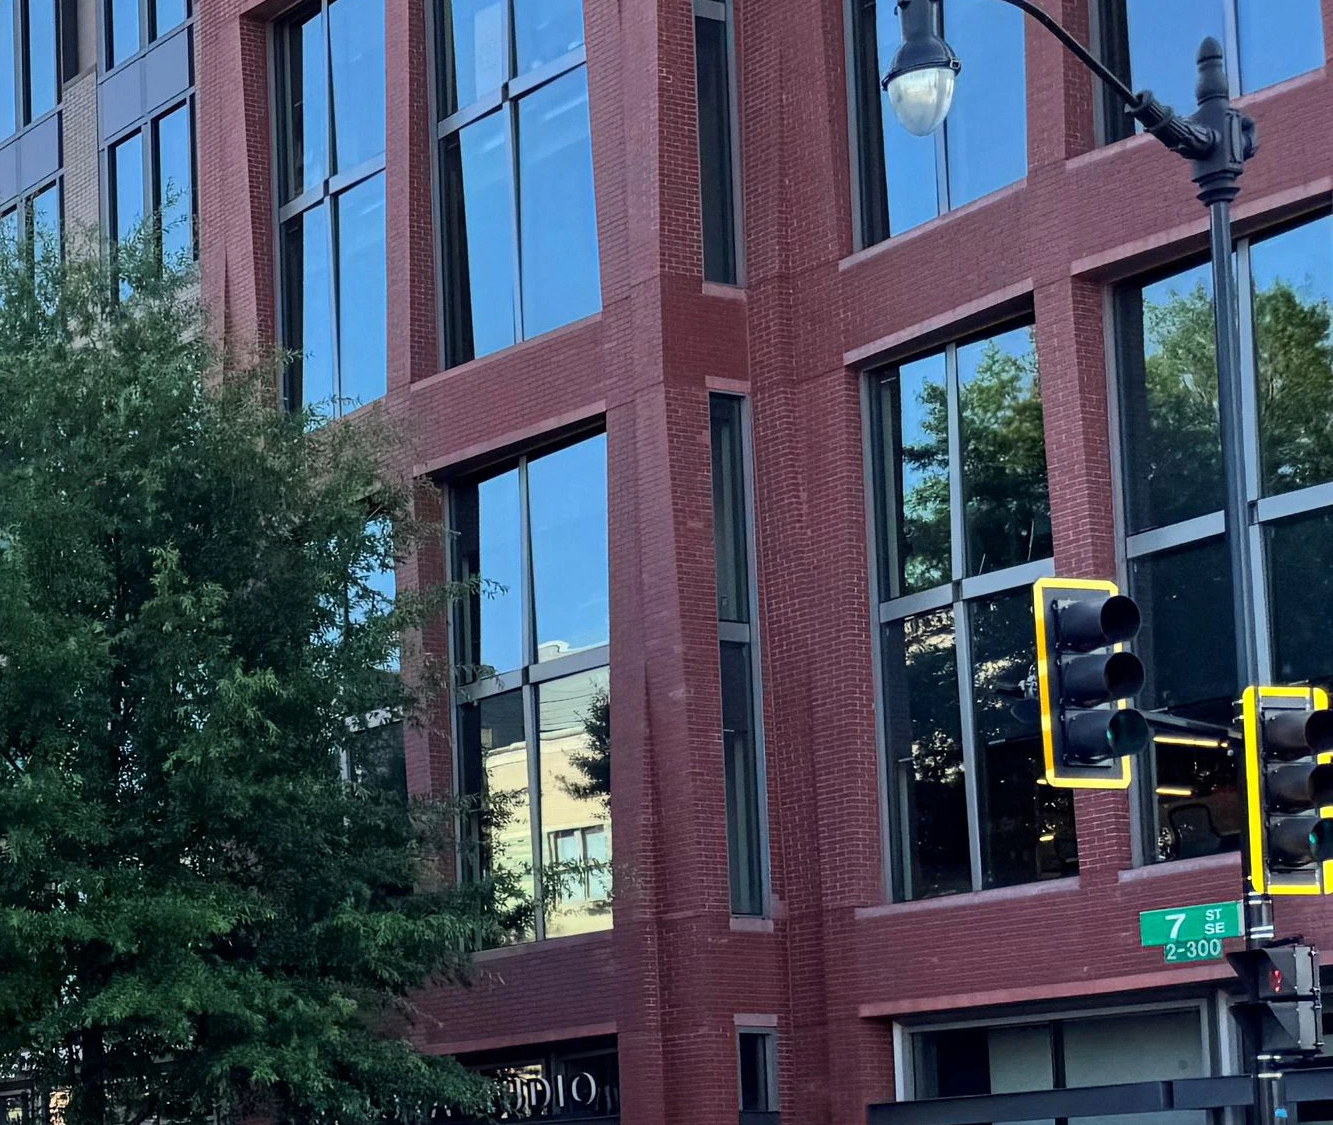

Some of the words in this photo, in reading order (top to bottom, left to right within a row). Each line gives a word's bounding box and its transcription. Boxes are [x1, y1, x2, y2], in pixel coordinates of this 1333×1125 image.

[1165, 913, 1186, 939] 7
[1205, 908, 1222, 921] ST
[1204, 922, 1225, 935] SE
[1165, 938, 1222, 960] 2-300
